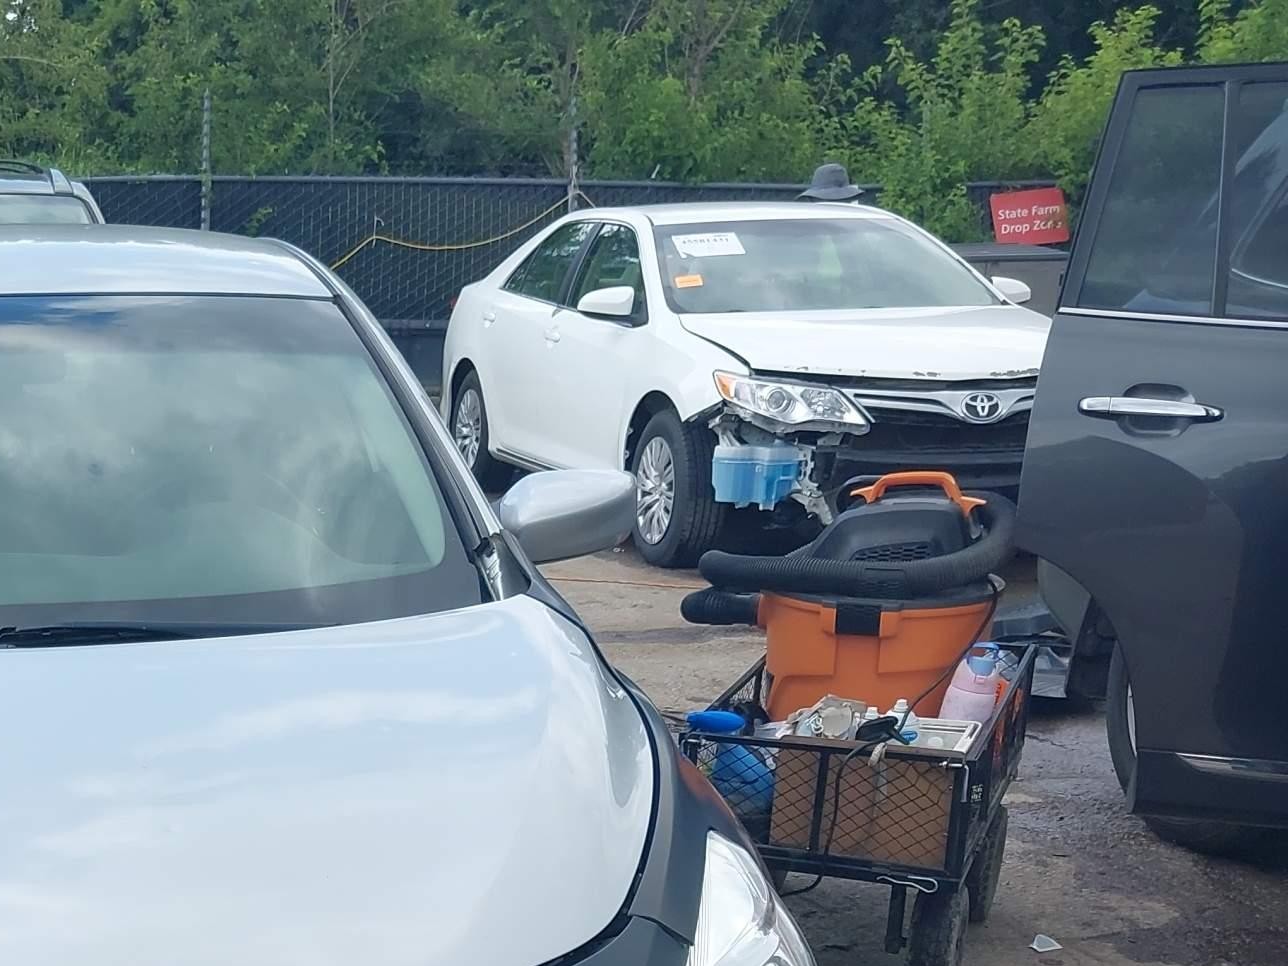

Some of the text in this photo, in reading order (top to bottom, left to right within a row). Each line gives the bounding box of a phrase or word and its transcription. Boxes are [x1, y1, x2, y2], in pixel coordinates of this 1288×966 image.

[997, 205, 1060, 220] State Farm
[1001, 223, 1030, 234] Drop
